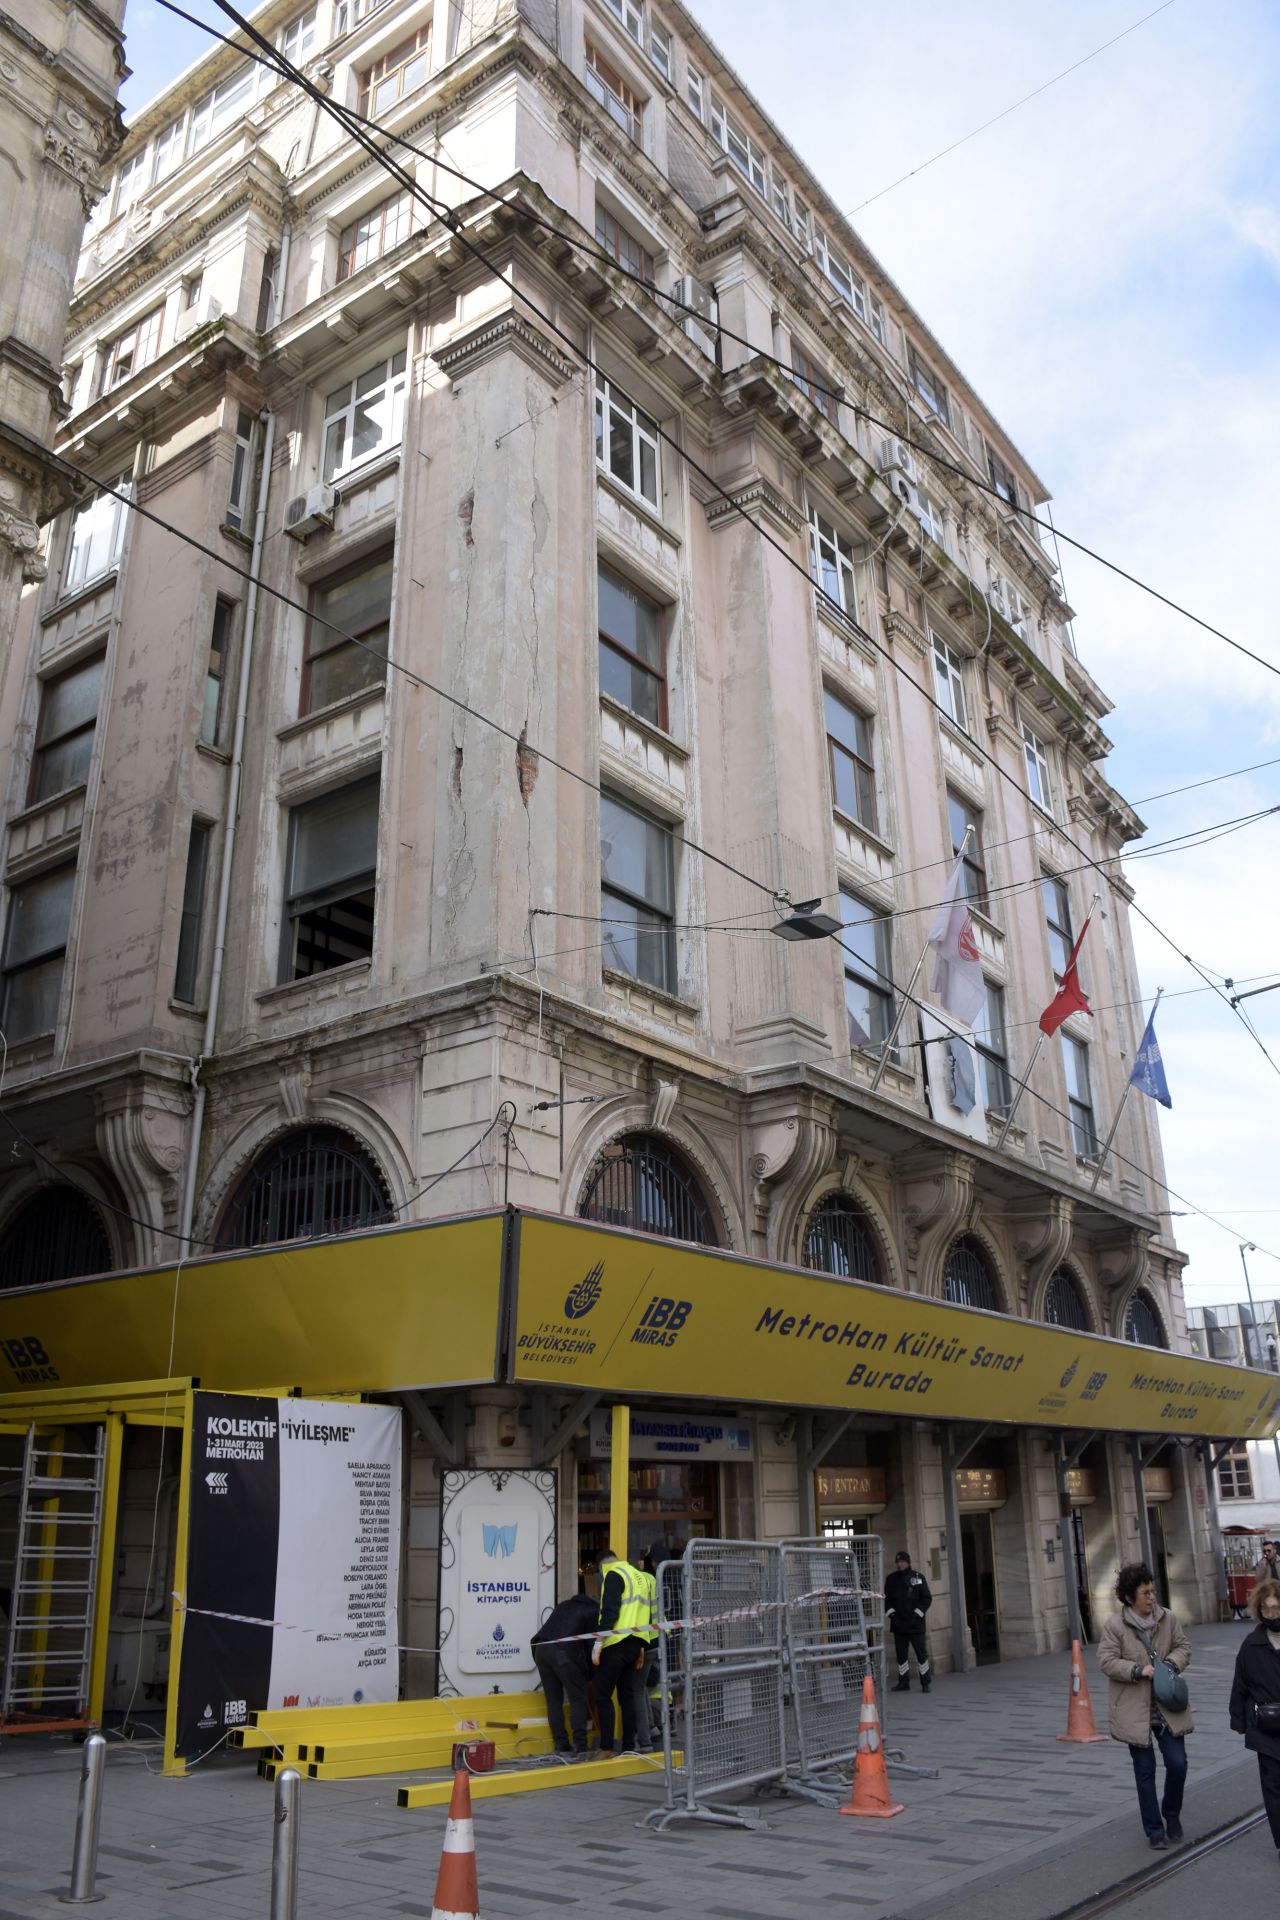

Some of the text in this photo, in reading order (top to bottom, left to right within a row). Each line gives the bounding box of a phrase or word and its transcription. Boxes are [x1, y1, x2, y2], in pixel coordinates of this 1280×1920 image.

[538, 1323, 592, 1337] İSTANBUL
[517, 1333, 596, 1355] BÜYÜKŞEHİR
[755, 1307, 1025, 1372] MetroHan Kültür Sanat
[522, 1352, 578, 1366] BELEDİYESİ
[846, 1363, 933, 1394] Burada
[1129, 1373, 1245, 1402] MetroHan Kültür Sanat
[1160, 1402, 1199, 1419] Burada
[206, 1416, 277, 1439] KOLEKTİF
[281, 1418, 355, 1446] "İYİLEŞME"
[246, 1441, 264, 1450] 2023
[206, 1447, 264, 1461] METROHAN
[209, 1487, 228, 1495] 1.KAT
[361, 1508, 374, 1516] LEYLA
[359, 1517, 377, 1525] TRACEY
[361, 1545, 374, 1553] LEYLA
[364, 1573, 388, 1581] ORLANDO
[467, 1580, 531, 1592] İSTANBUL
[371, 1600, 386, 1609] POLAT
[477, 1595, 521, 1604] KİTAPÇISI
[373, 1658, 387, 1666] OKAY
